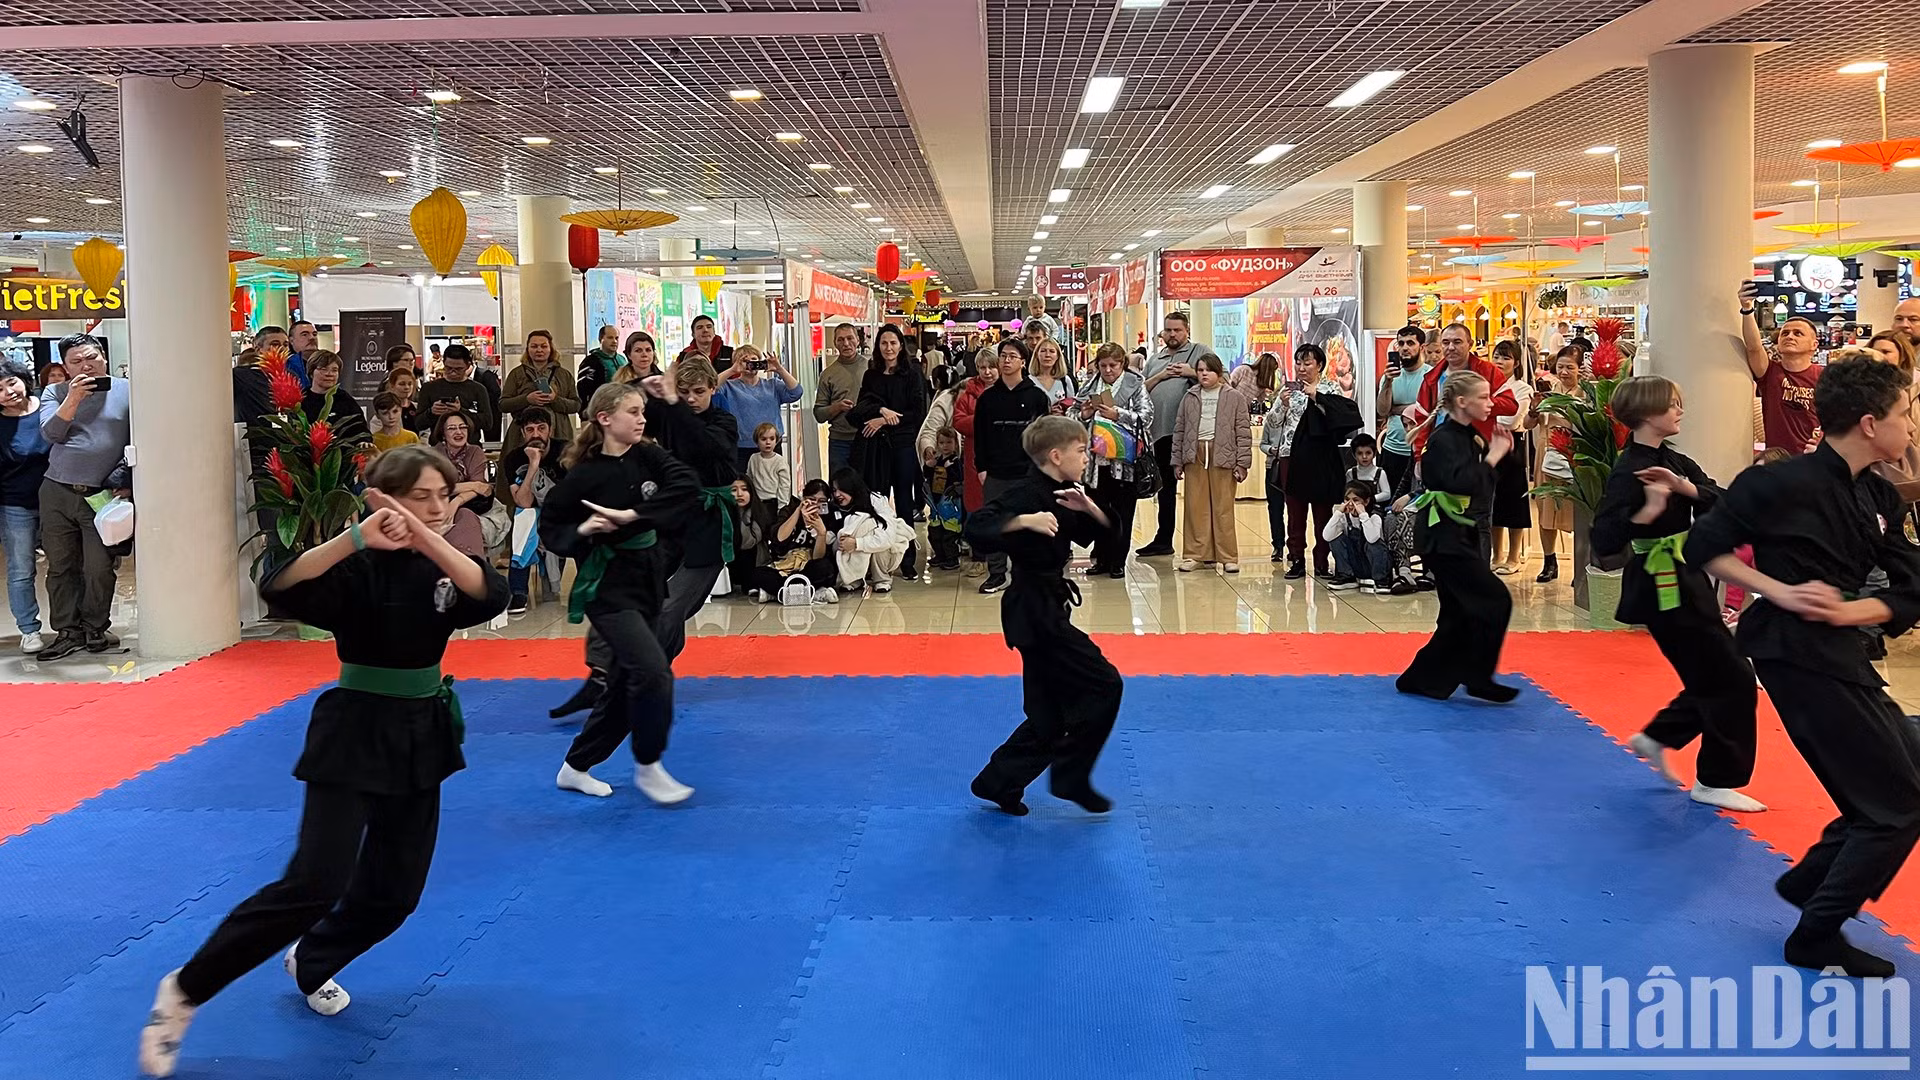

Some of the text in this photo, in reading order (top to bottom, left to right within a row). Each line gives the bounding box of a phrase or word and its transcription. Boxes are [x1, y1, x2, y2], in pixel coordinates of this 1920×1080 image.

[1170, 257, 1294, 273] ООО «ФУДЗОН»
[0, 280, 126, 311] ietFres
[1324, 286, 1338, 296] 26
[355, 360, 387, 374] Legend
